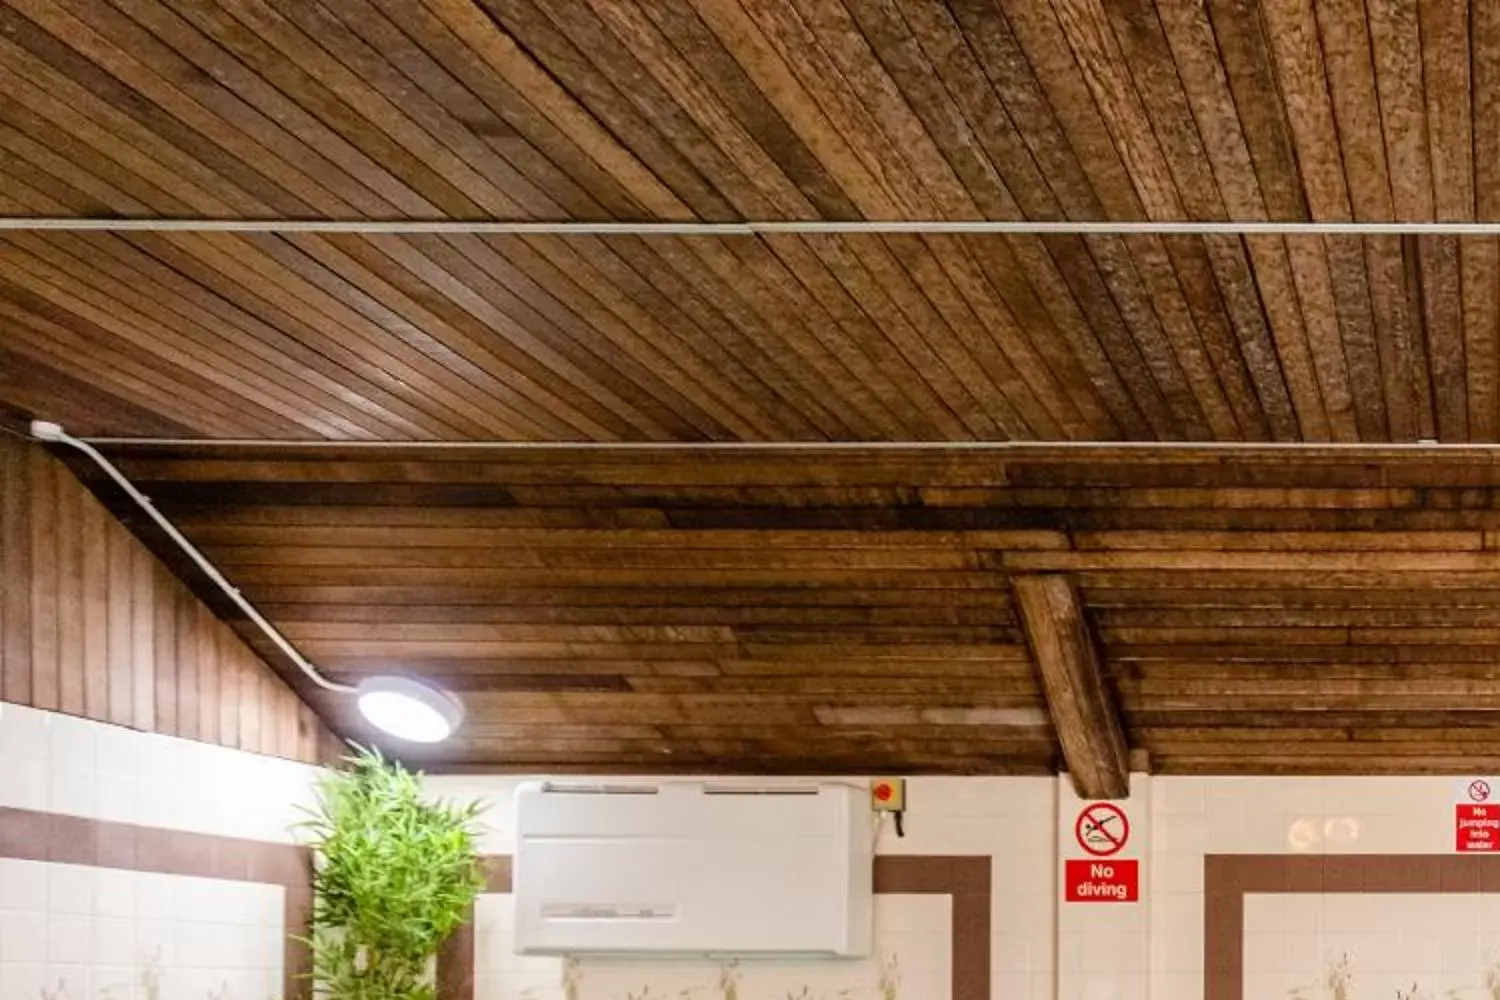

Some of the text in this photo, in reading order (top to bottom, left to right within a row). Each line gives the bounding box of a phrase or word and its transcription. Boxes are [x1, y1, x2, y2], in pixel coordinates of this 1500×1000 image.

[1473, 807, 1487, 817] No
[1459, 817, 1499, 829] jumping
[1470, 829, 1490, 839] into
[1466, 840, 1494, 849] water
[1091, 863, 1115, 879] No
[1077, 881, 1127, 900] diving
